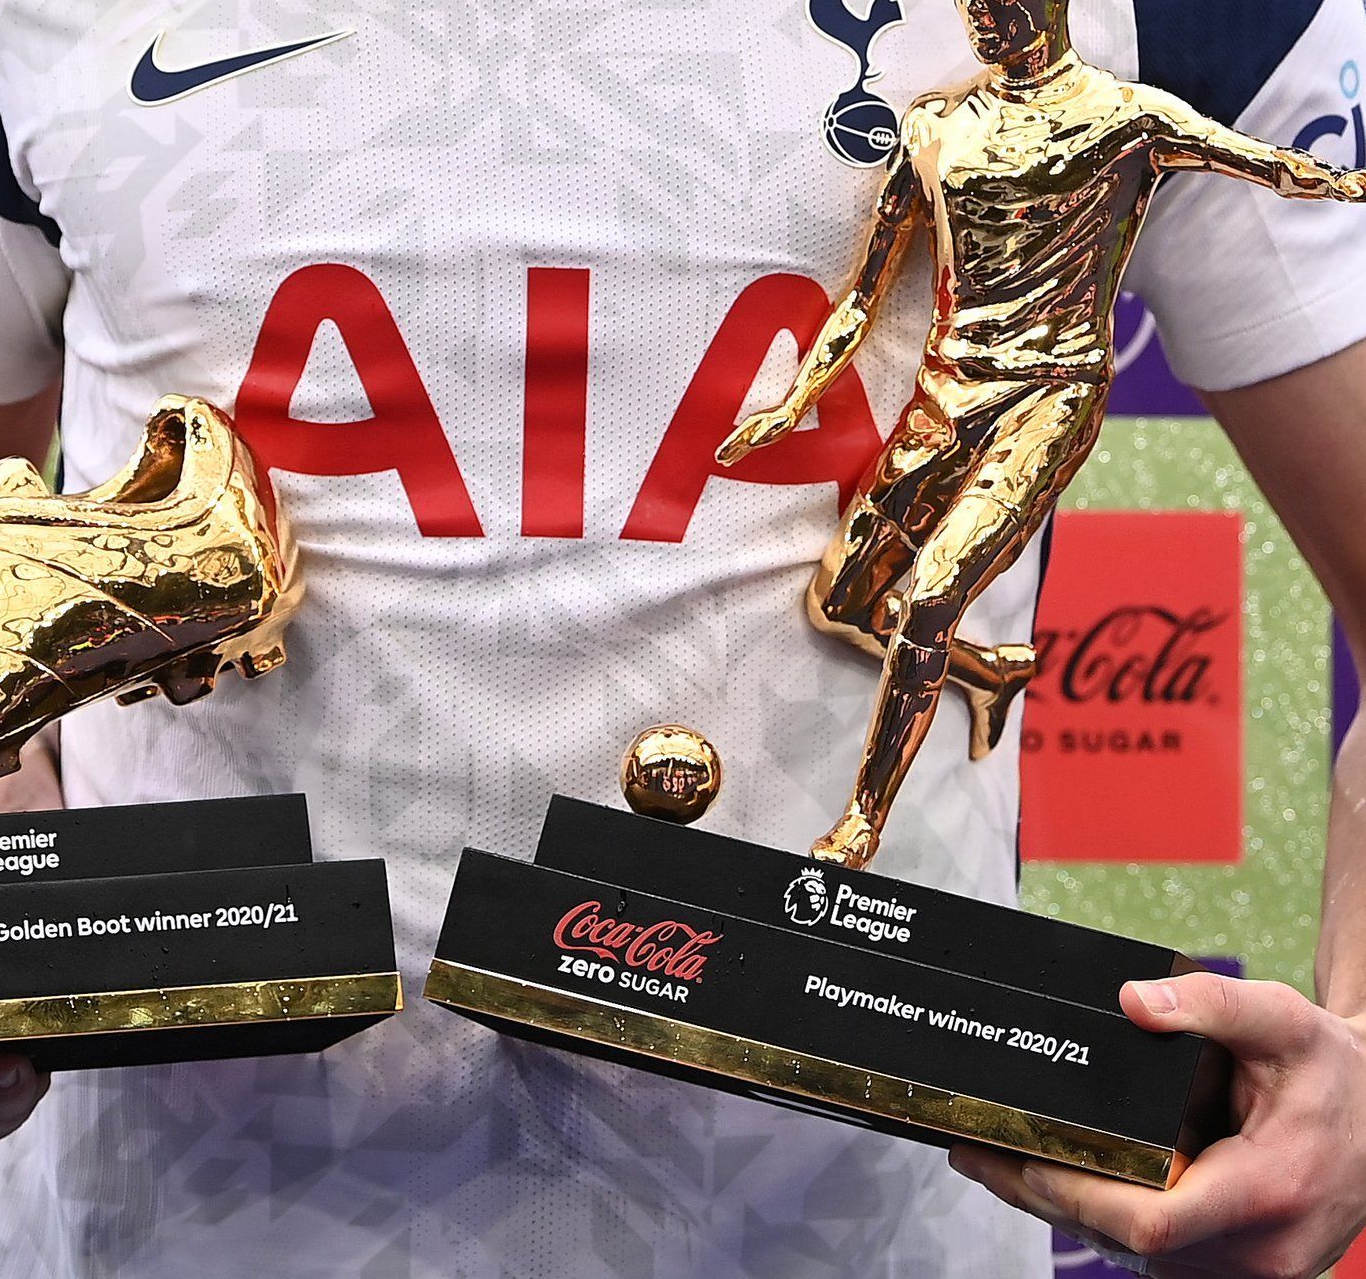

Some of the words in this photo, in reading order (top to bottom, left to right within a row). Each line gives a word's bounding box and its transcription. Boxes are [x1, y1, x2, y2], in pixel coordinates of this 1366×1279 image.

[235, 263, 887, 544] AIA
[1058, 729, 1182, 753] SUGAR
[77, 913, 131, 936] Boot
[134, 909, 212, 933] winner
[215, 903, 299, 929] 2020/21
[830, 904, 911, 943] League
[835, 884, 917, 923] Premier
[553, 900, 724, 982] Coca-Cola
[557, 954, 615, 984] zero
[618, 971, 689, 1003] SUGAR
[803, 975, 925, 1023] Playmaker
[928, 1009, 1005, 1043] winner
[1006, 1027, 1090, 1066] 2020/21
